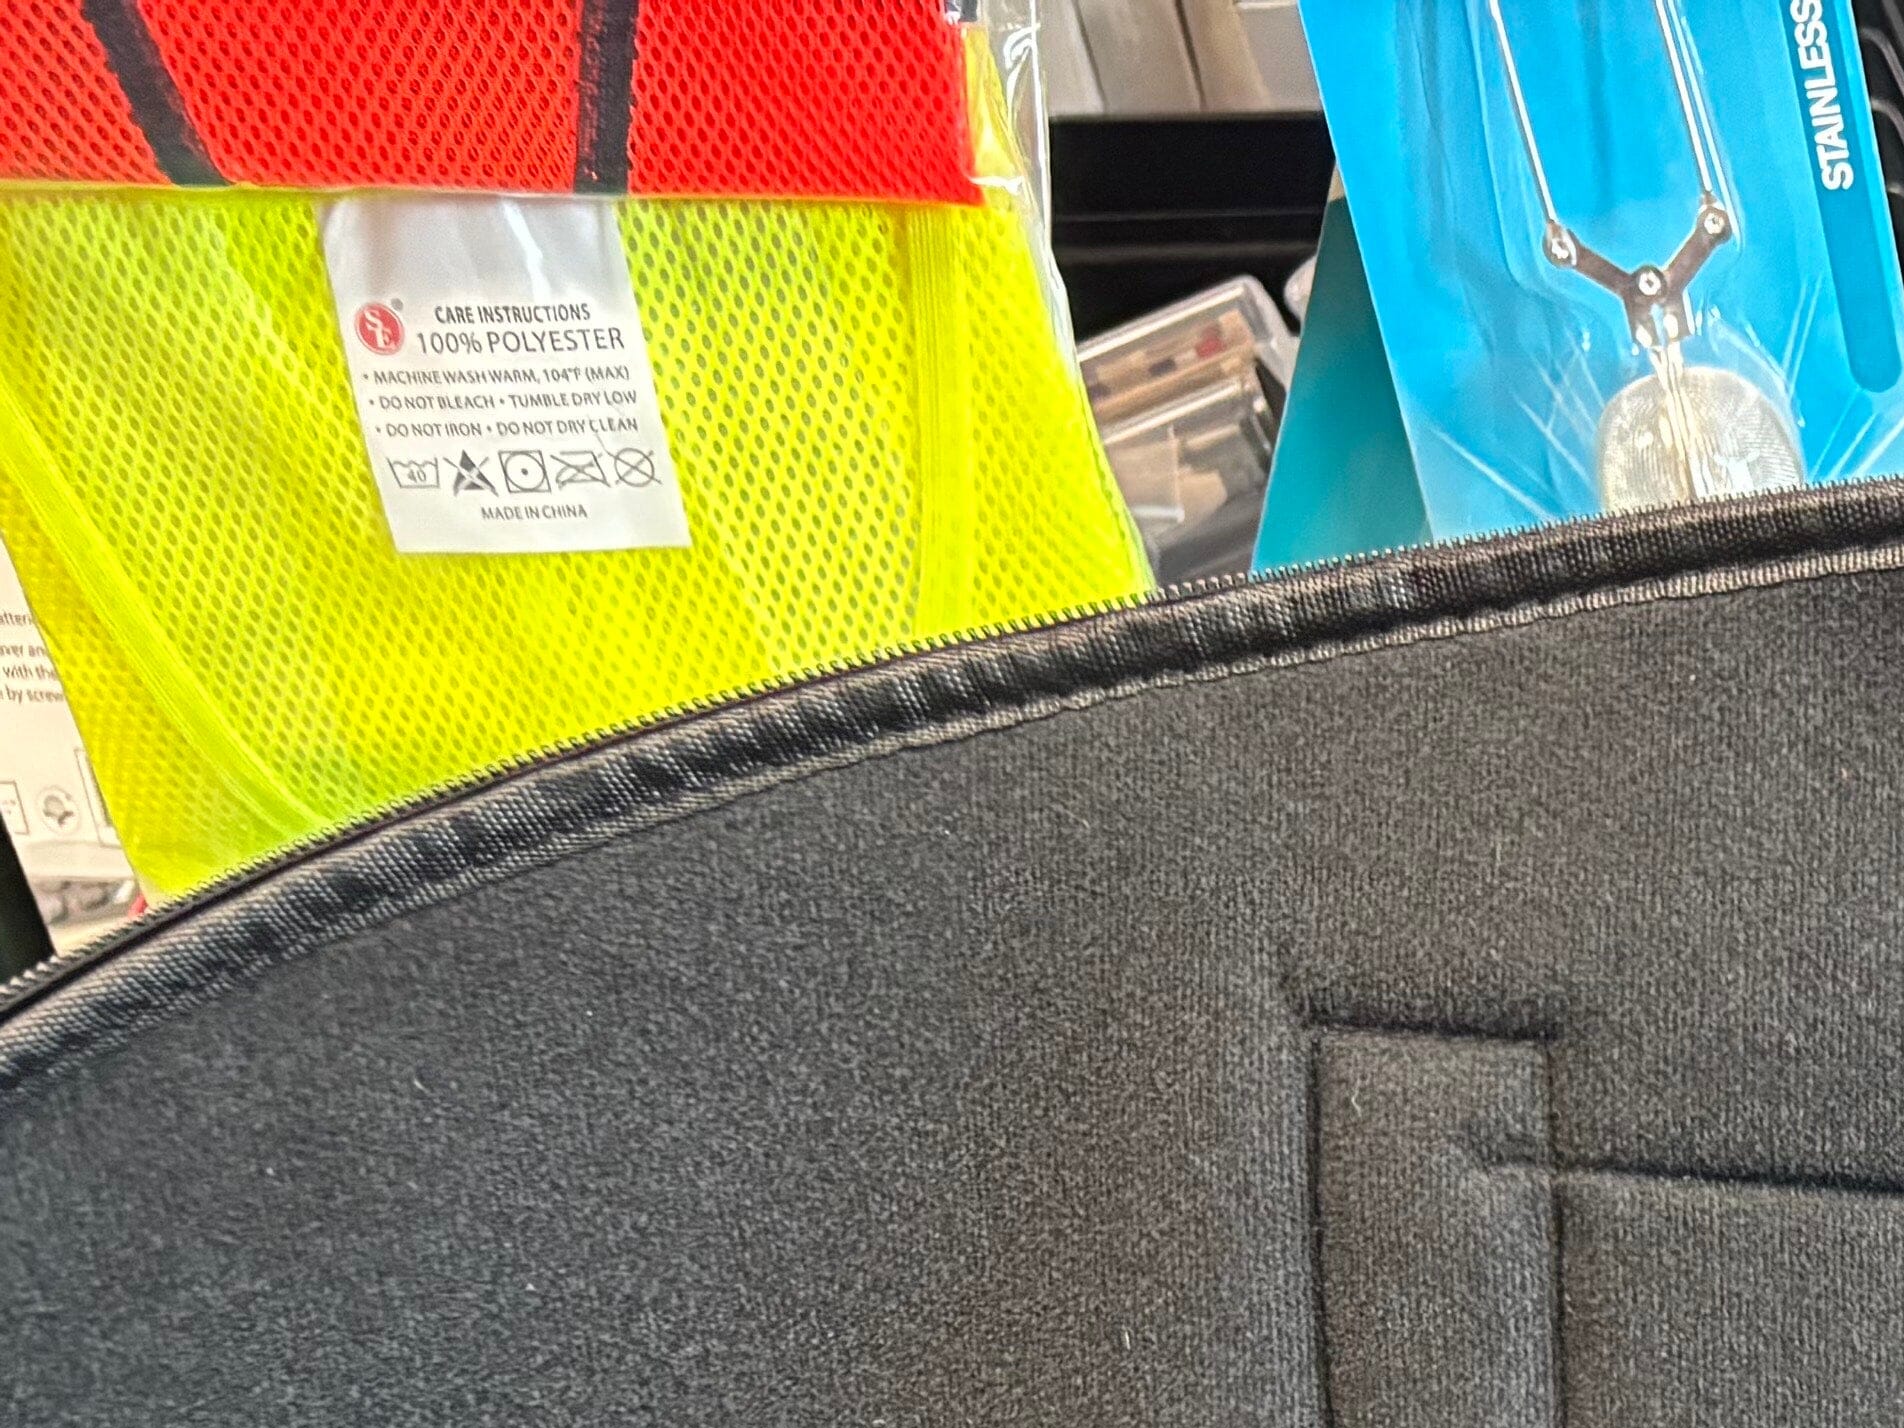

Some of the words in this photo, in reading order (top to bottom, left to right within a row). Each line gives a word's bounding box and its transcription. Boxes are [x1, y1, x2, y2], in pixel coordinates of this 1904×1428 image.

[1790, 0, 1854, 191] STAINLESS
[434, 305, 475, 324] CARE
[477, 303, 591, 323] INSTRUCTIONS
[417, 331, 483, 354] 100%
[486, 327, 625, 353] POLYESTER
[373, 370, 442, 385] MACHINE
[443, 370, 487, 385] WASH
[488, 368, 541, 385] WARM,
[585, 365, 630, 382] (MAX)
[379, 395, 402, 410] DO
[404, 395, 435, 410] NOT
[437, 394, 496, 410] BLEACH
[508, 391, 570, 408] TUMBLE
[571, 391, 602, 407] DRY
[604, 390, 637, 406] LOW
[386, 423, 409, 438] DO
[411, 423, 442, 437] NOT
[444, 422, 483, 437] IRON
[496, 421, 520, 437] DO
[522, 420, 553, 436] NOT
[556, 419, 586, 434] DRY
[589, 417, 639, 434] CLEAN
[480, 506, 523, 521] MADE
[524, 505, 541, 520] IN
[542, 504, 588, 520] CHINA
